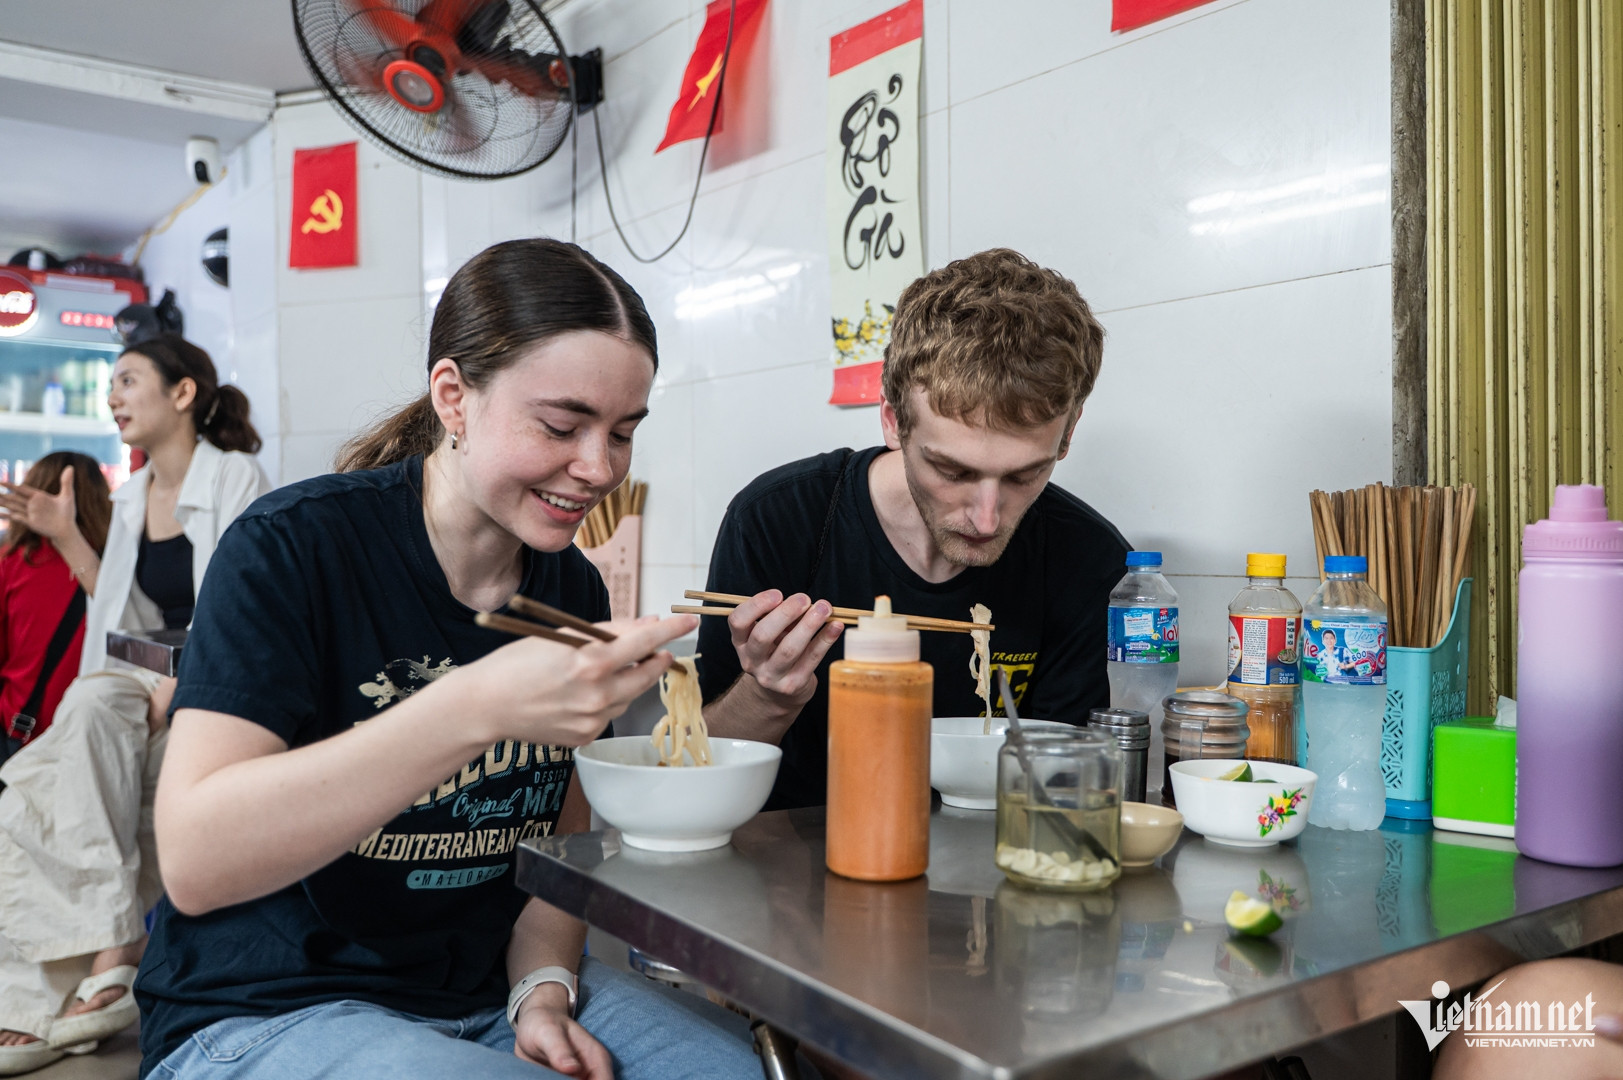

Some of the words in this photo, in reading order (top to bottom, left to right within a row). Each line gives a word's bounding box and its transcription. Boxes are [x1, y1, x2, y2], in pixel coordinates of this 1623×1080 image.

[844, 185, 906, 275] Gà
[991, 651, 1038, 662] TRAEGER
[1352, 651, 1367, 661] 600
[534, 768, 567, 784] DESIGN
[452, 788, 522, 826] Original
[521, 781, 564, 817] MCA
[349, 827, 520, 861] MEDITERRANEAN
